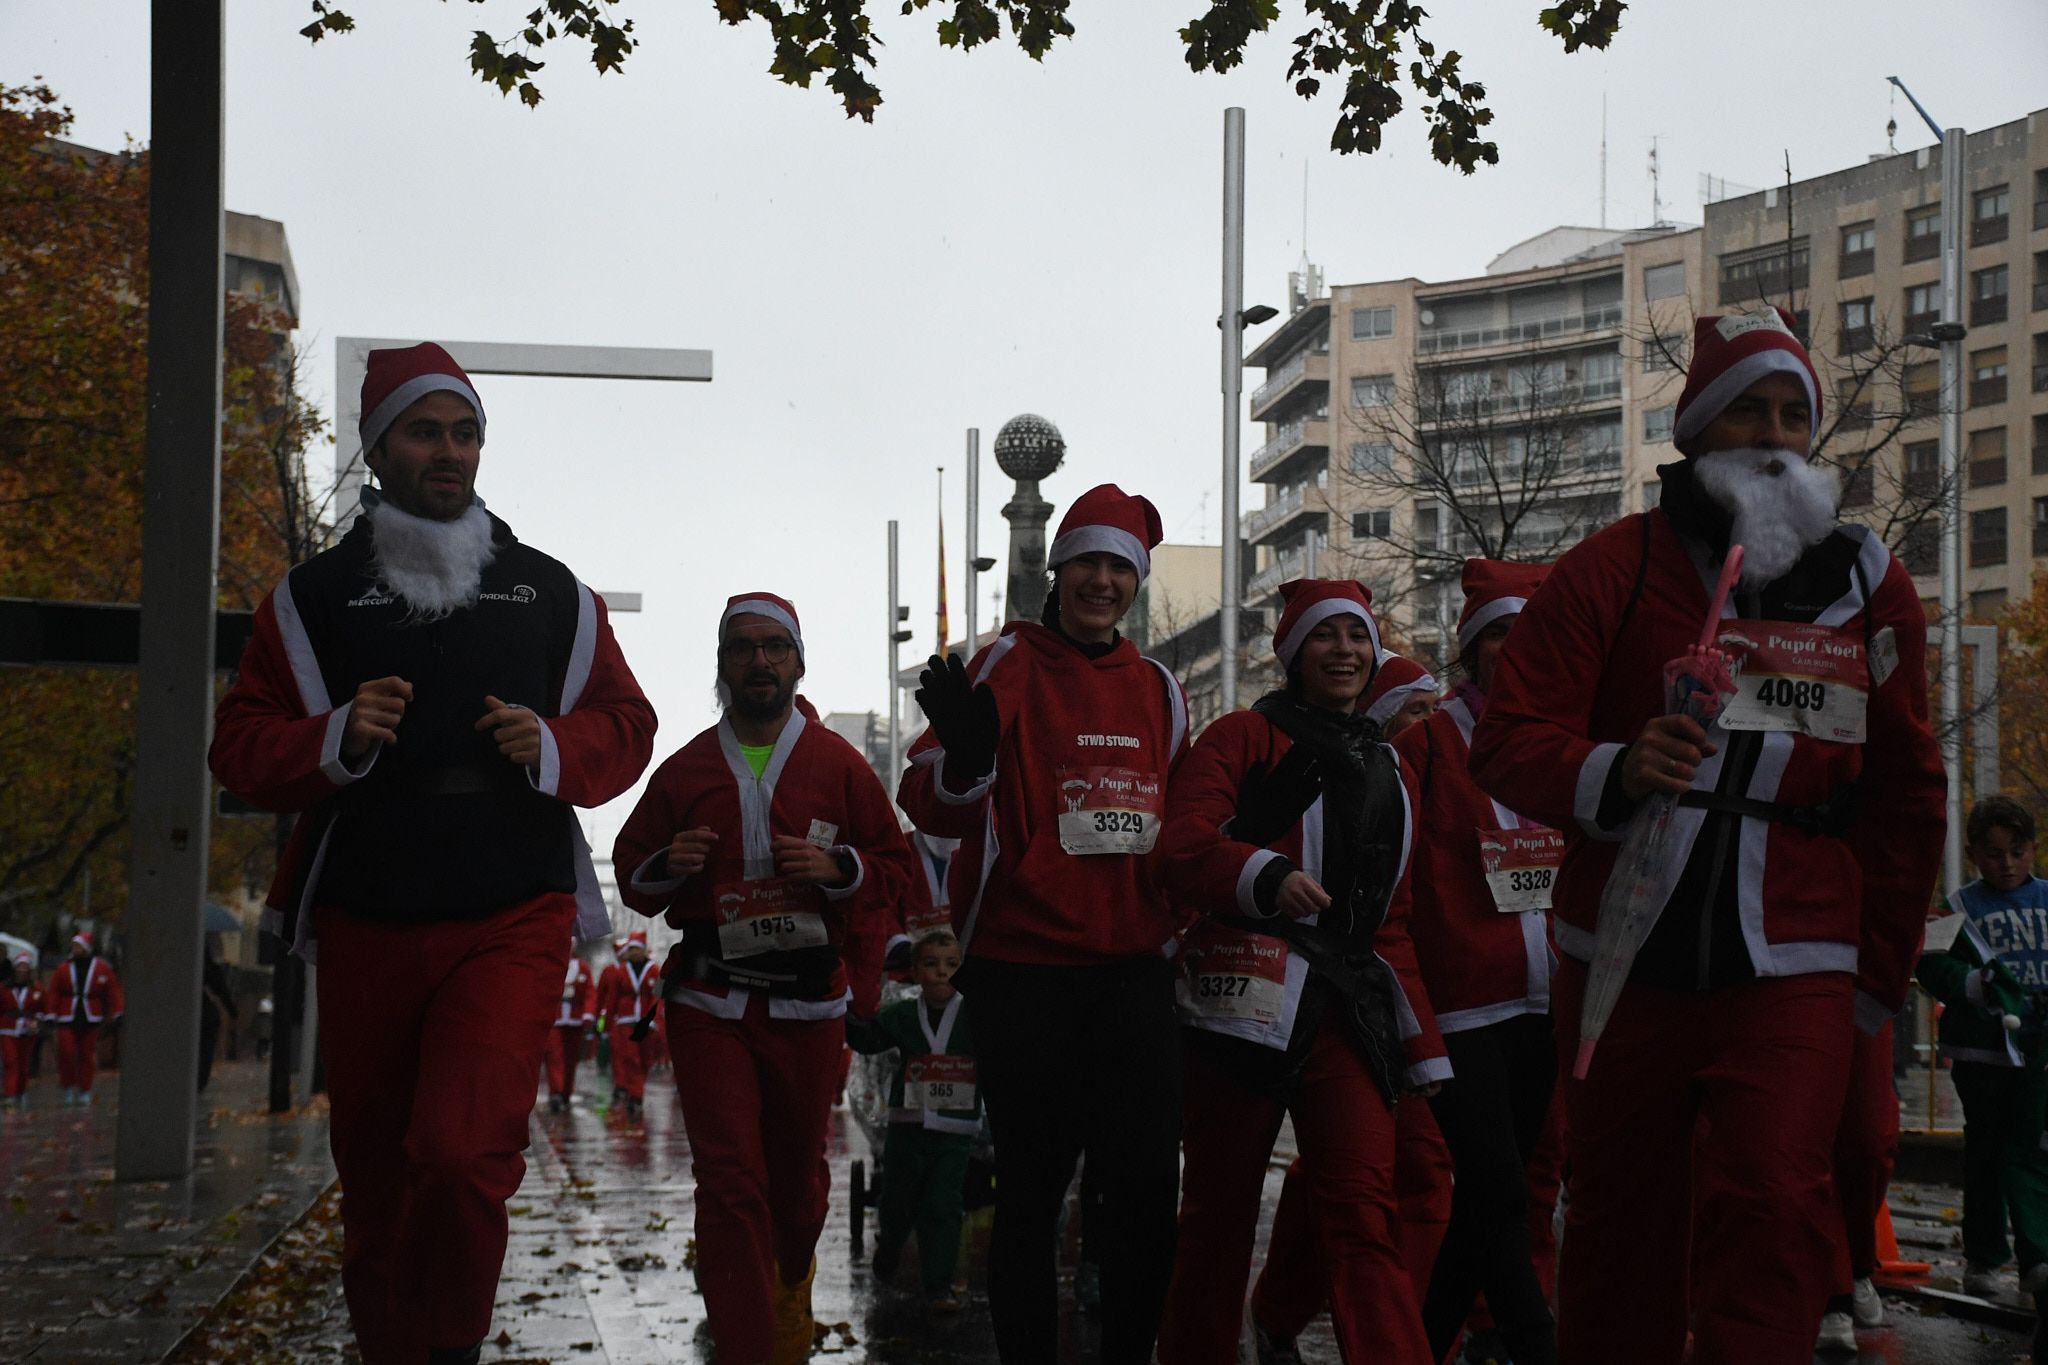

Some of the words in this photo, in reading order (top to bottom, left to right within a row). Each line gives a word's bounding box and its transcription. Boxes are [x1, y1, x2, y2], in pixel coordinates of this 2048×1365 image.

[347, 597, 394, 607] MERCURY
[479, 593, 529, 603] PADELZGZ
[1768, 635, 1816, 653] Papá
[1823, 640, 1858, 659] Noel
[1757, 678, 1825, 711] 4089
[1077, 734, 1105, 746] STWD
[1106, 735, 1140, 749] STUDIO
[1099, 776, 1132, 792] Papá
[1135, 780, 1158, 795] Noel
[1094, 812, 1143, 834] 3329
[1513, 836, 1545, 851] Papá
[1510, 869, 1551, 892] 3328
[752, 885, 783, 900] Papá
[750, 916, 796, 937] 1975
[1211, 942, 1245, 957] Papá
[1249, 943, 1281, 959] Noel
[1200, 976, 1250, 997] 3327
[930, 1083, 953, 1097] 365
